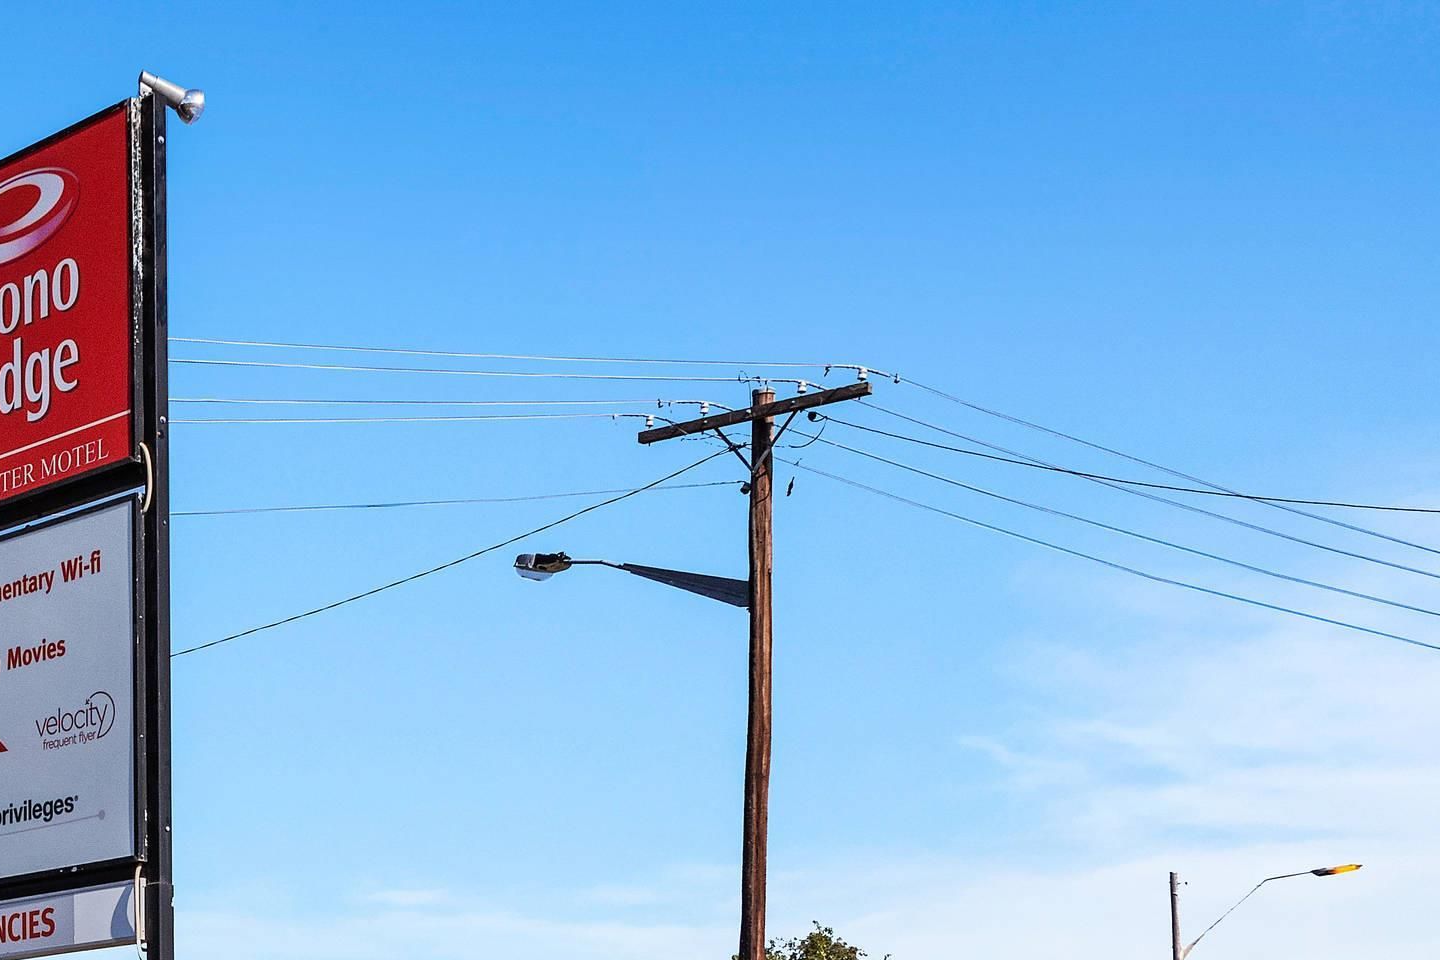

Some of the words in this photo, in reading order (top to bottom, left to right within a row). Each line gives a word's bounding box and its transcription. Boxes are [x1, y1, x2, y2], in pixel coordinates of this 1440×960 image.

[40, 438, 110, 475] MOTEL
[60, 549, 101, 583] Wi-fi
[7, 638, 66, 671] Movies
[35, 702, 108, 737] velocity
[42, 736, 77, 751] frequent
[78, 730, 98, 745] flyer
